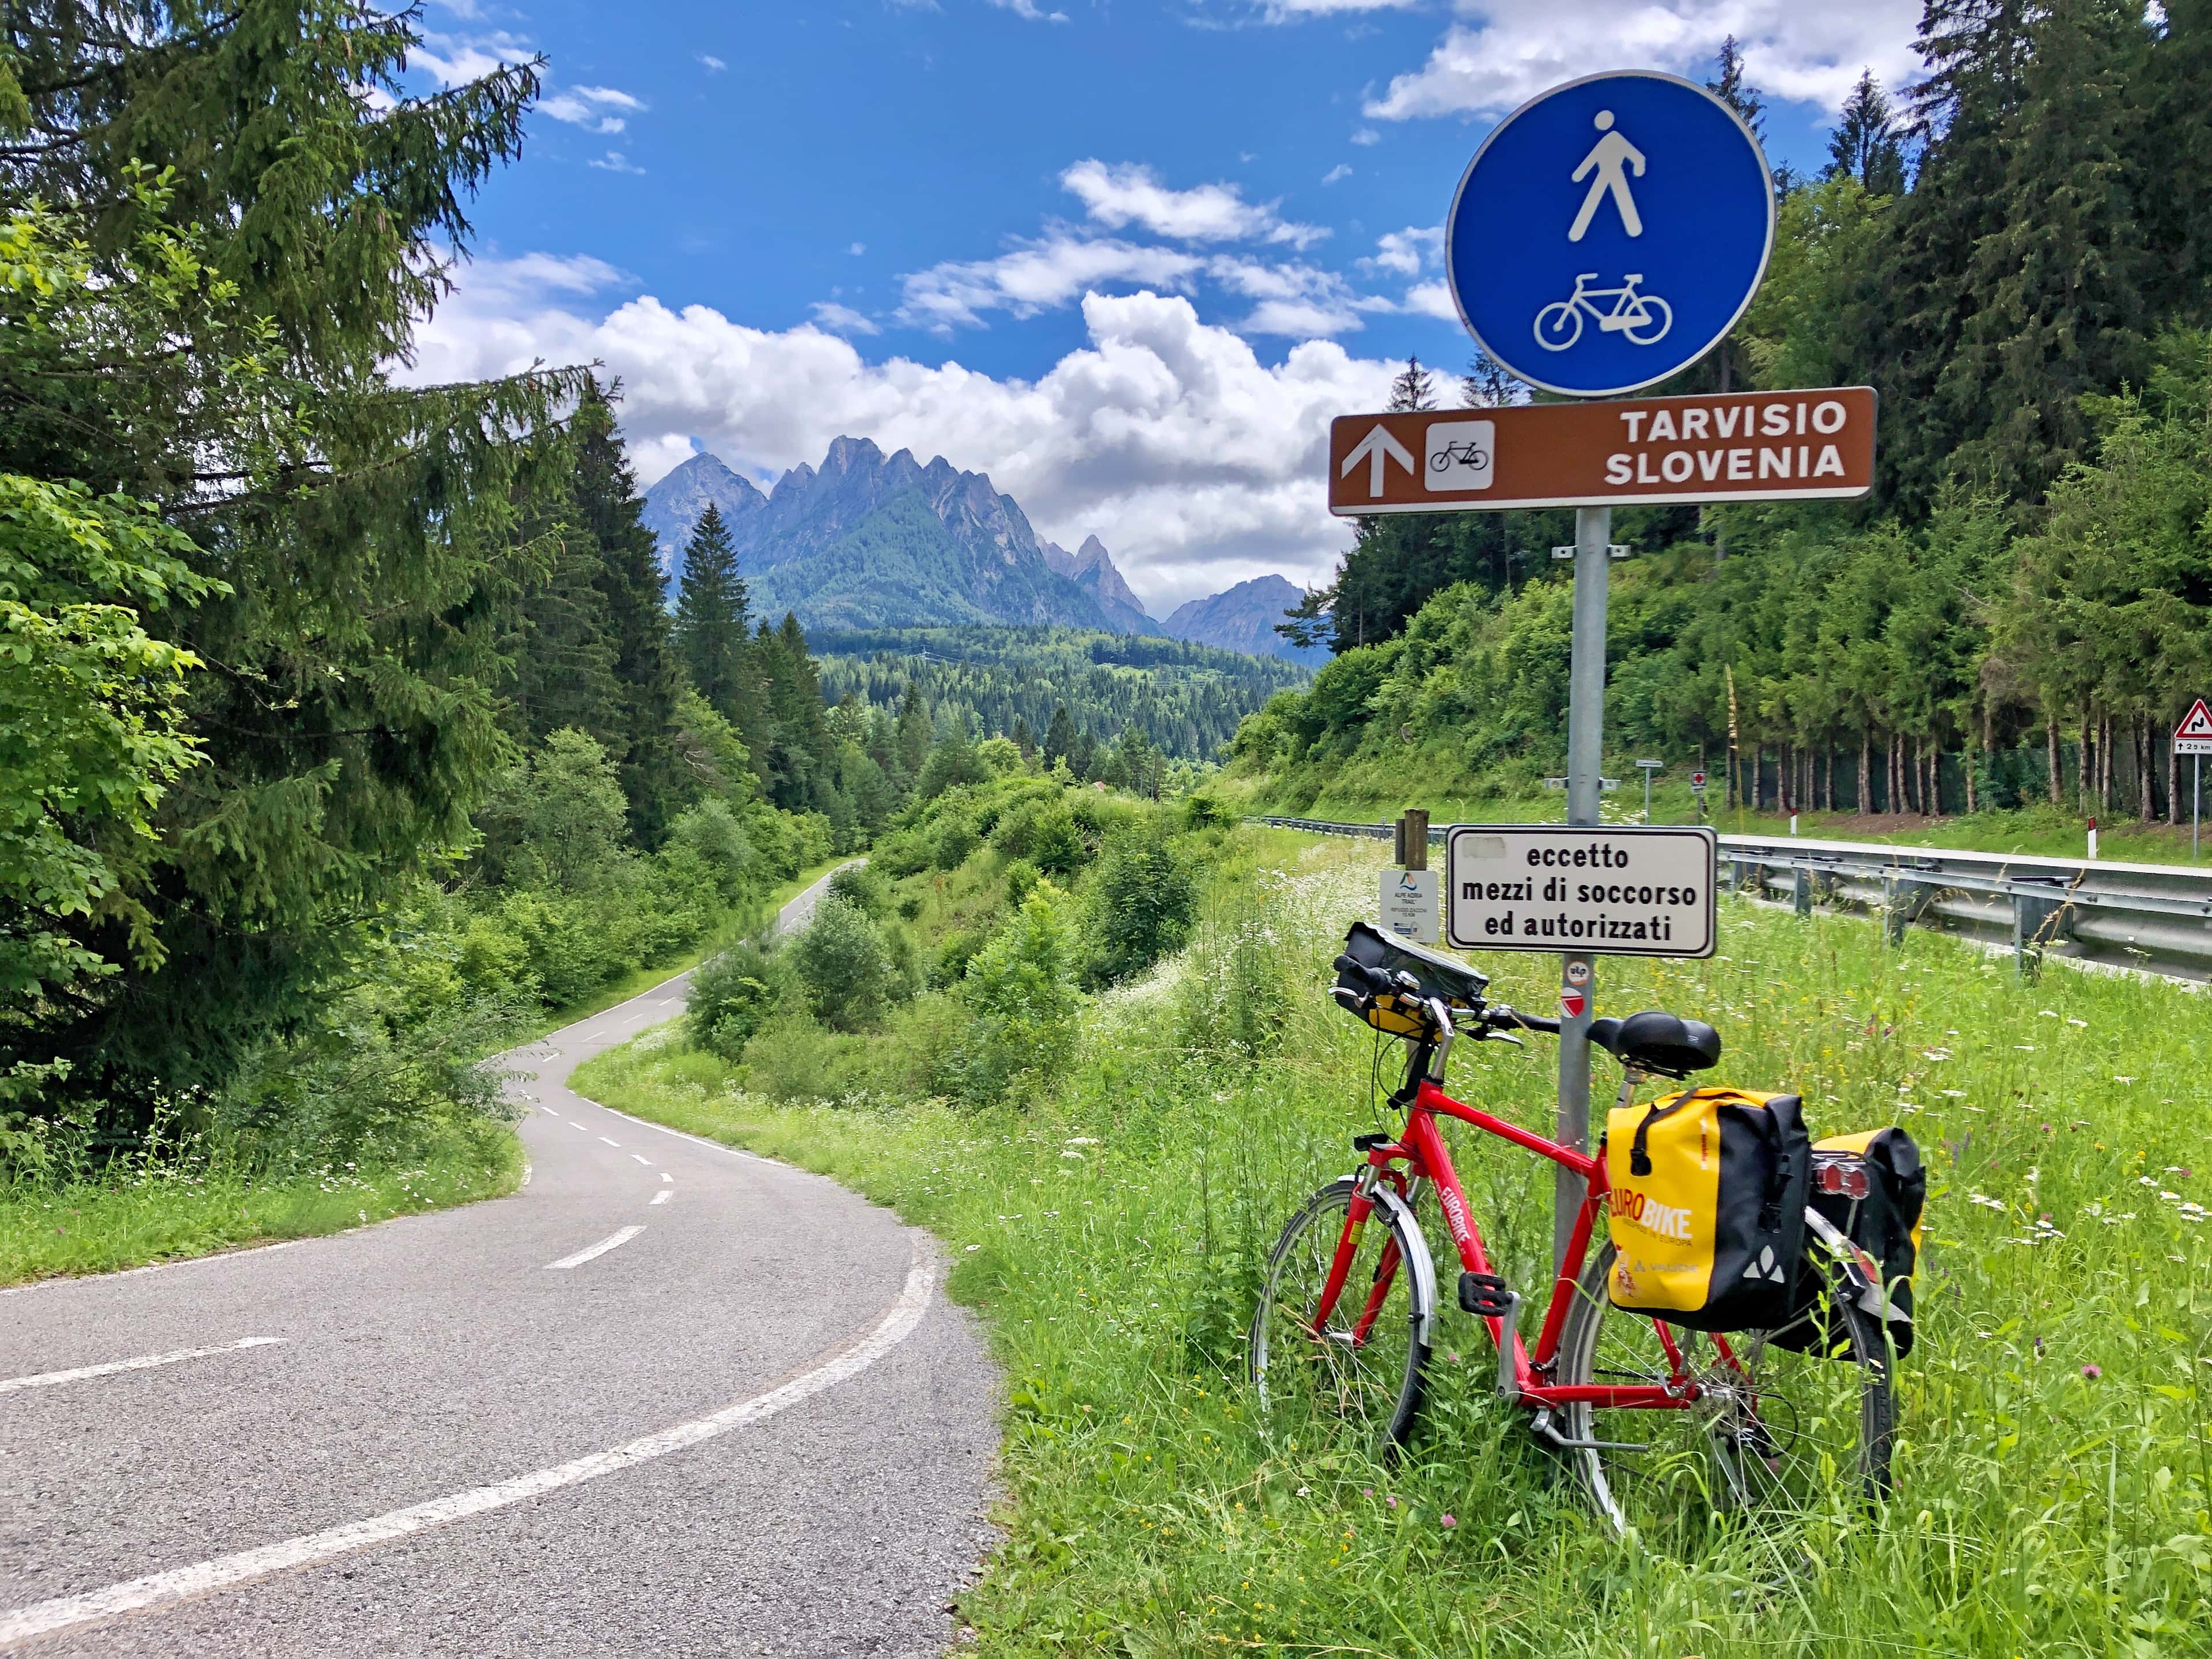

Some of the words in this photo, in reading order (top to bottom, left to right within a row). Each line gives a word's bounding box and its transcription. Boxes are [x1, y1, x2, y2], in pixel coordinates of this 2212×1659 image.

[1620, 401, 1847, 442] TARVISIO
[1604, 444, 1845, 485] SLOVENIA
[1527, 843, 1628, 869] eccetto
[1463, 876, 1532, 901] mezzi
[1543, 876, 1566, 902] di
[1577, 884, 1696, 906] soccorso
[1485, 910, 1513, 935] ed
[1524, 912, 1670, 941] autorizzati
[1440, 1186, 1471, 1247] EUROBIKE
[1609, 1188, 1693, 1239] EUROBIKE
